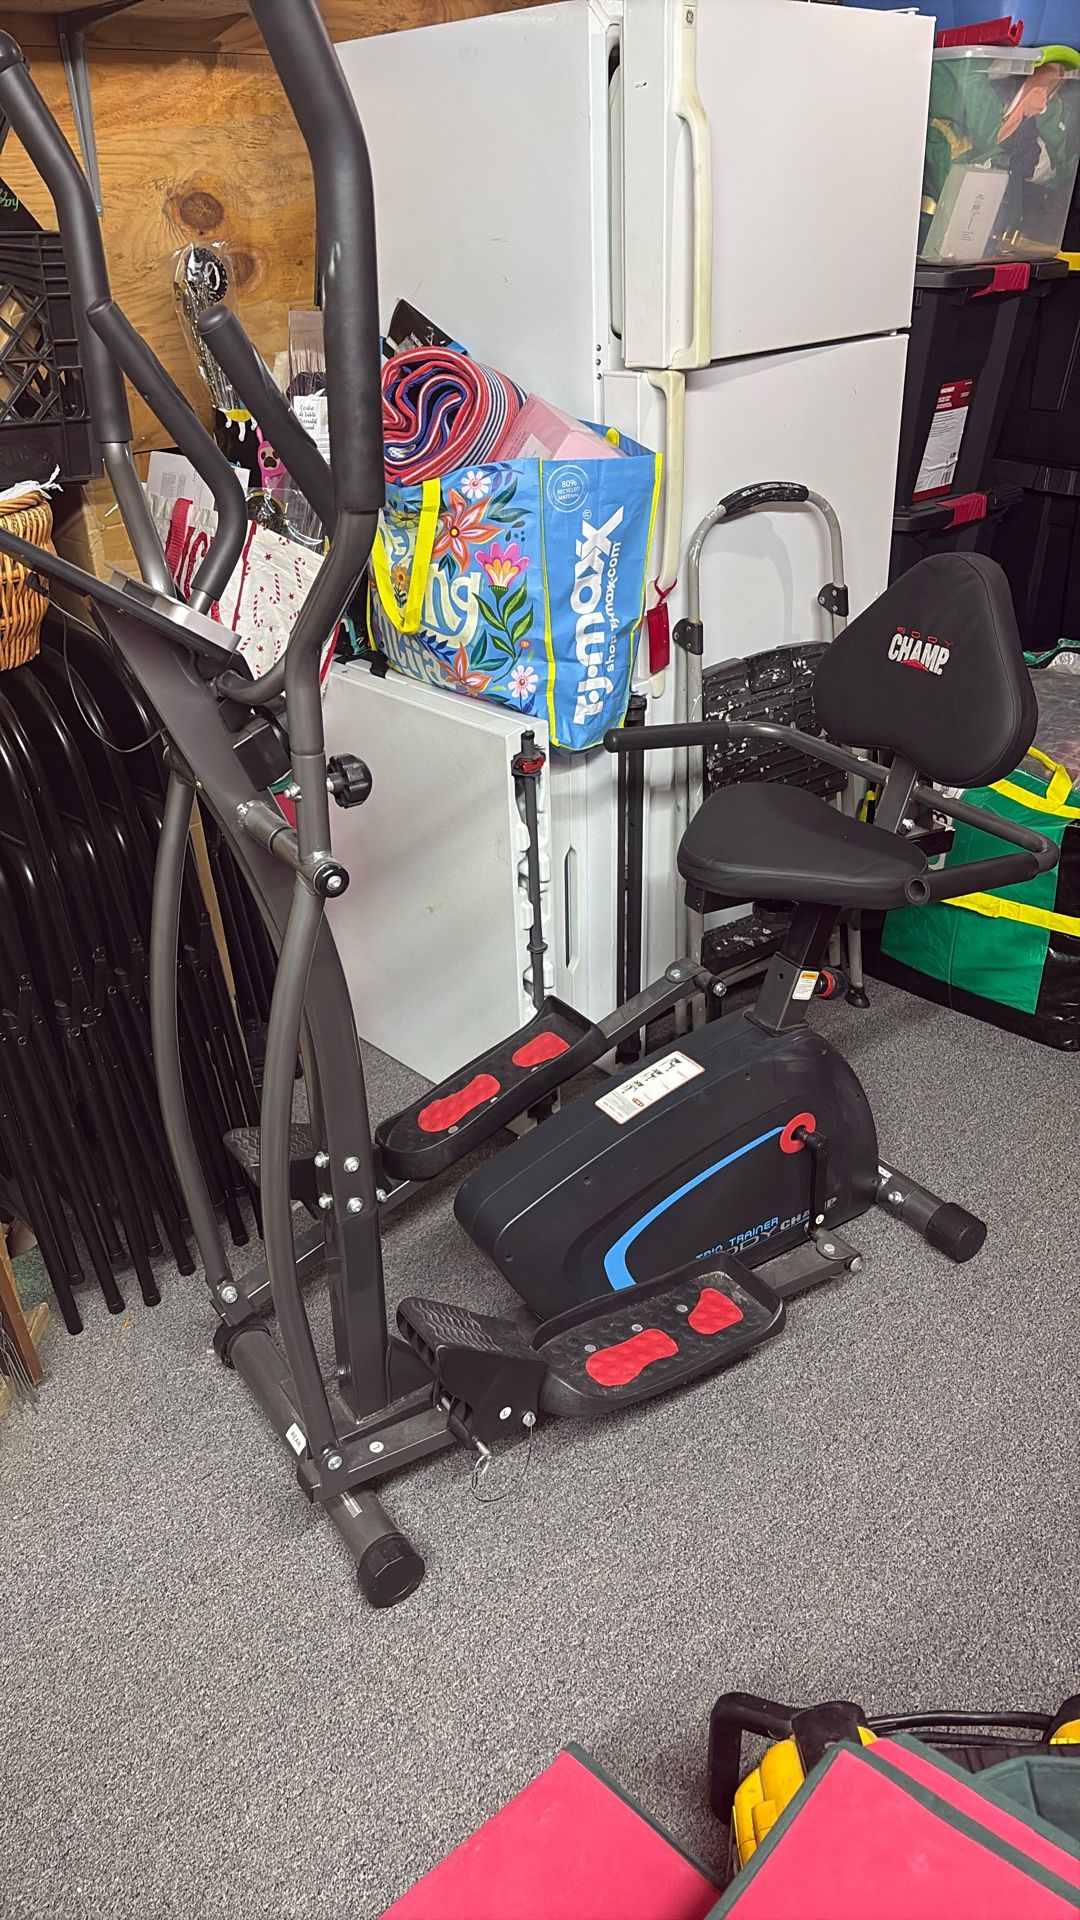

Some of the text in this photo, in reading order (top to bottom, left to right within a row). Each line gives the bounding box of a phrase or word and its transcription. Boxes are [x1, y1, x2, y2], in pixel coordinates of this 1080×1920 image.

[561, 480, 577, 488] 80%
[888, 633, 950, 675] CHAMP
[726, 1197, 837, 1257] ODY CHAP
[728, 1216, 779, 1247] TRAINER
